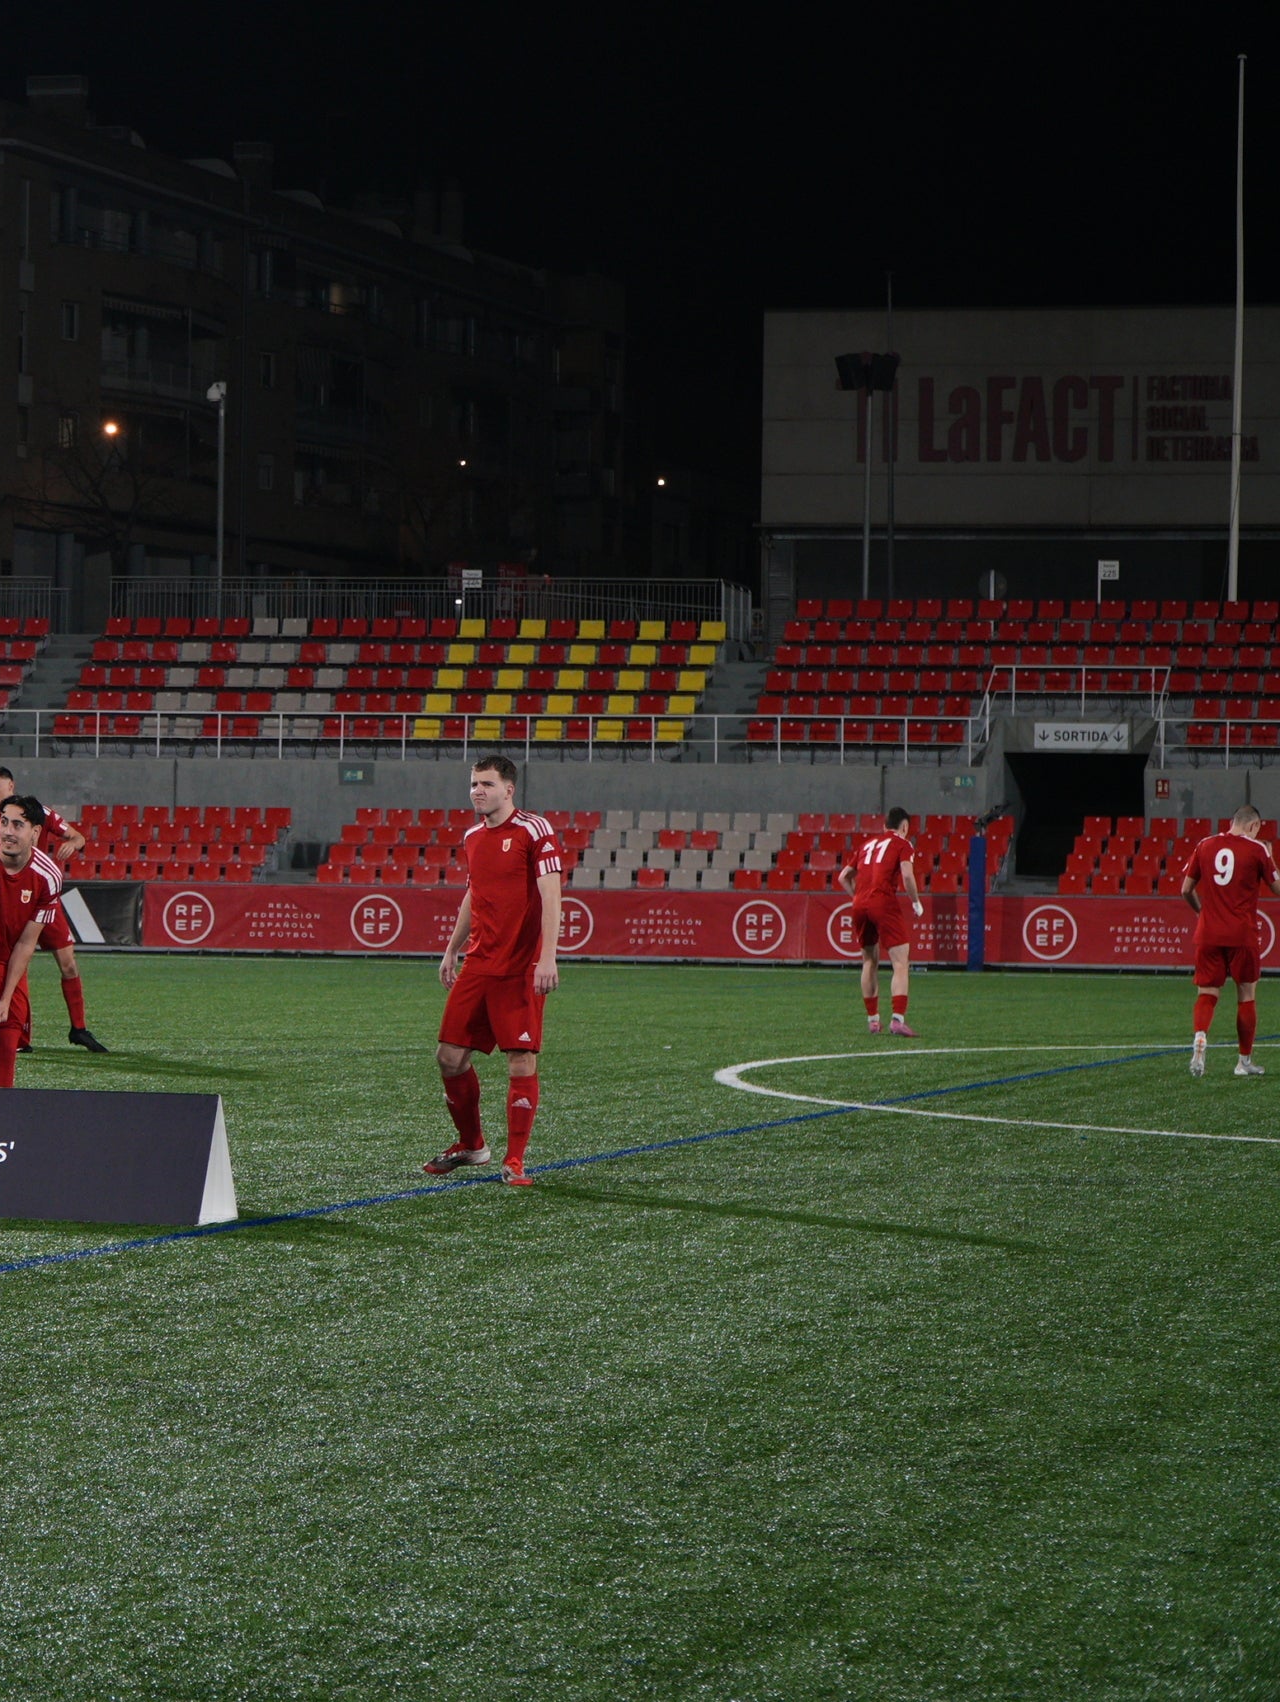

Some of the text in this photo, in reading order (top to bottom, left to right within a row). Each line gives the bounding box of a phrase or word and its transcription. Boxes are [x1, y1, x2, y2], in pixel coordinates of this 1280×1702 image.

[918, 375, 1124, 463] LaFACT
[1054, 730, 1108, 742] SORTIDA
[863, 838, 892, 865] 11
[1213, 848, 1235, 886] 9
[268, 902, 298, 910] REAL
[840, 915, 853, 928] R
[1134, 916, 1165, 924] REAL
[912, 923, 992, 931] FEDERACN
[840, 930, 859, 943] E
[919, 933, 969, 941] ESPAÑO
